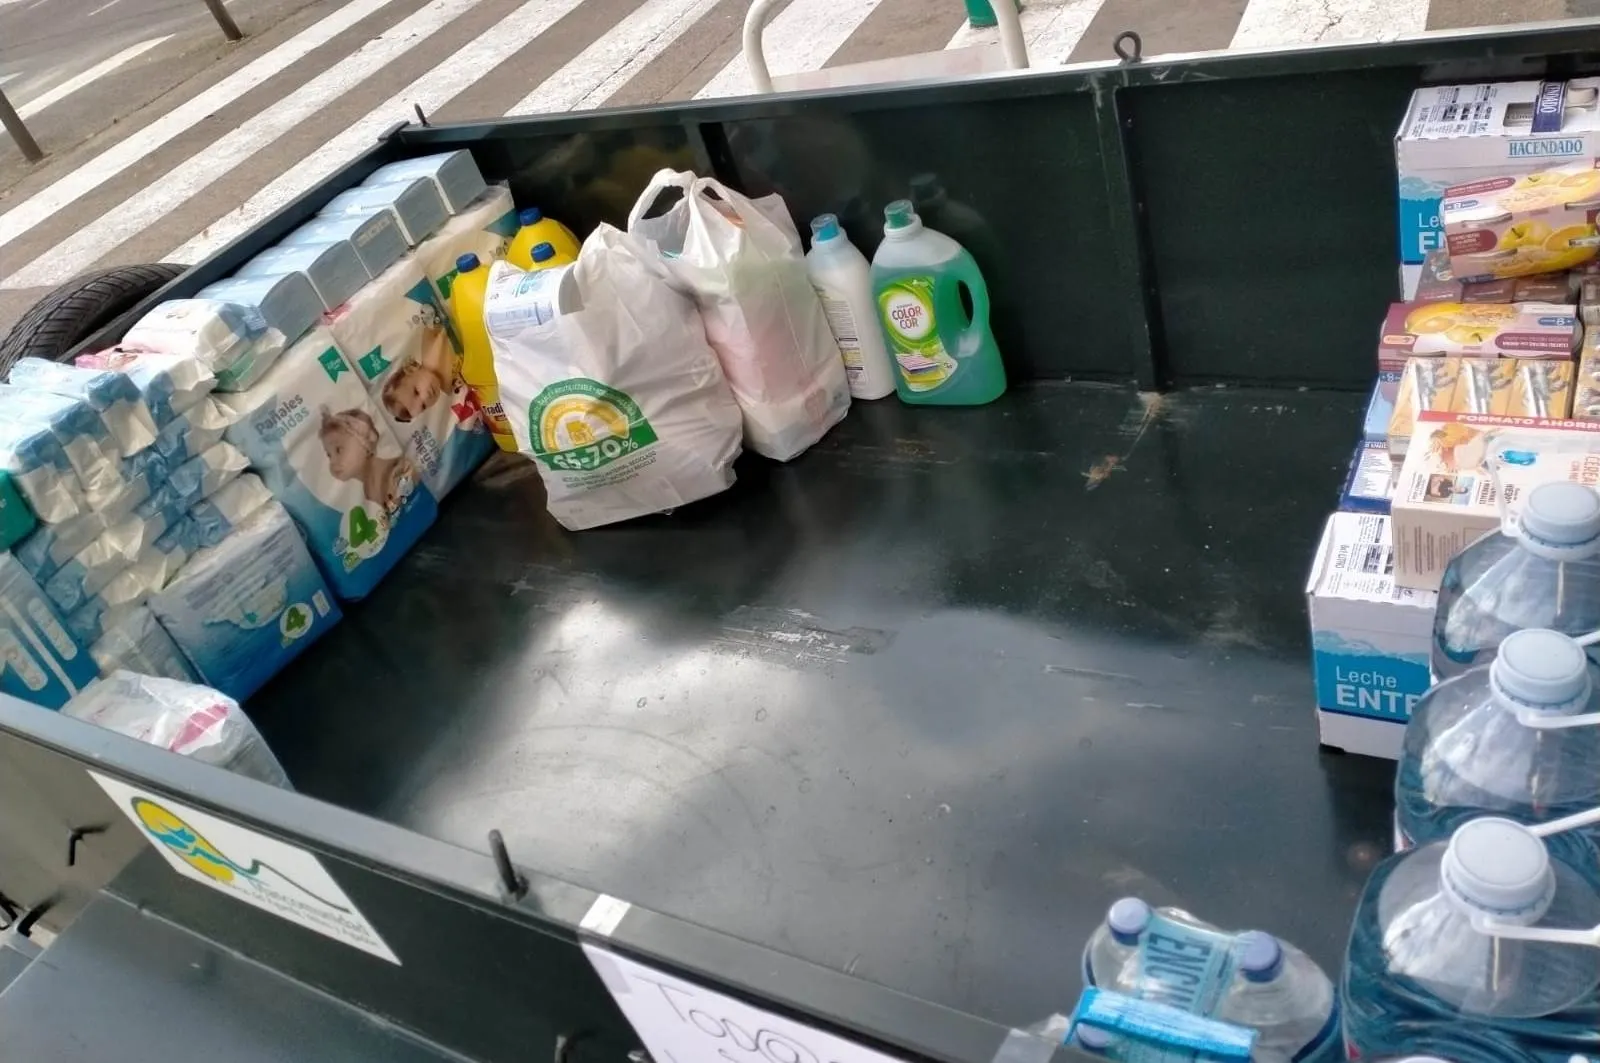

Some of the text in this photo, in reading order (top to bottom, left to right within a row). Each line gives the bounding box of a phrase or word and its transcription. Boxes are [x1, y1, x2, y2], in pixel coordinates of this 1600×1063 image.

[1508, 139, 1583, 156] HACENDADO
[892, 305, 922, 321] COLOR
[899, 317, 919, 330] COR
[254, 394, 303, 436] Pañales
[1456, 414, 1535, 425] FORMATO
[349, 506, 379, 549] 4
[286, 606, 306, 632] 4
[1335, 665, 1397, 689] Leche
[1144, 932, 1212, 1013] ENCIN
